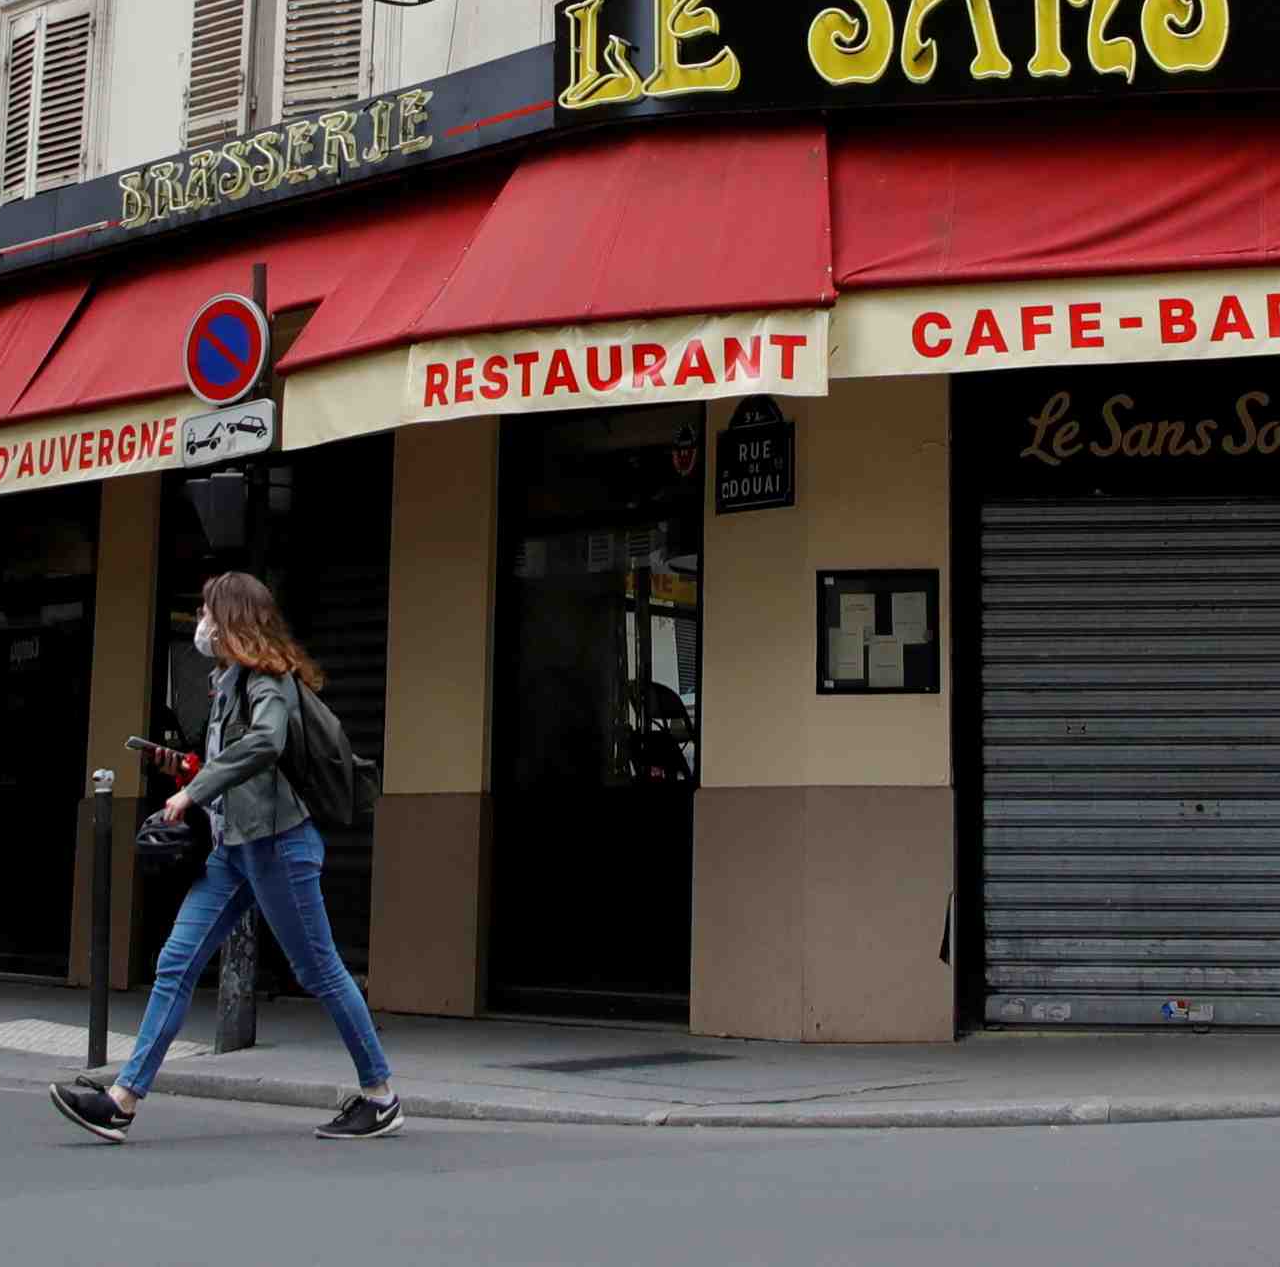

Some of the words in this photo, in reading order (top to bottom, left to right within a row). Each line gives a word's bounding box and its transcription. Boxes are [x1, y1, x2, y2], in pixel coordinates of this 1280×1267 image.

[119, 91, 433, 230] BRASSERIE
[422, 332, 809, 408] RESTAURANT
[738, 439, 772, 463] RUE
[1019, 391, 1084, 466] Le
[1089, 393, 1218, 457] Sans
[730, 474, 781, 498] DOUAI
